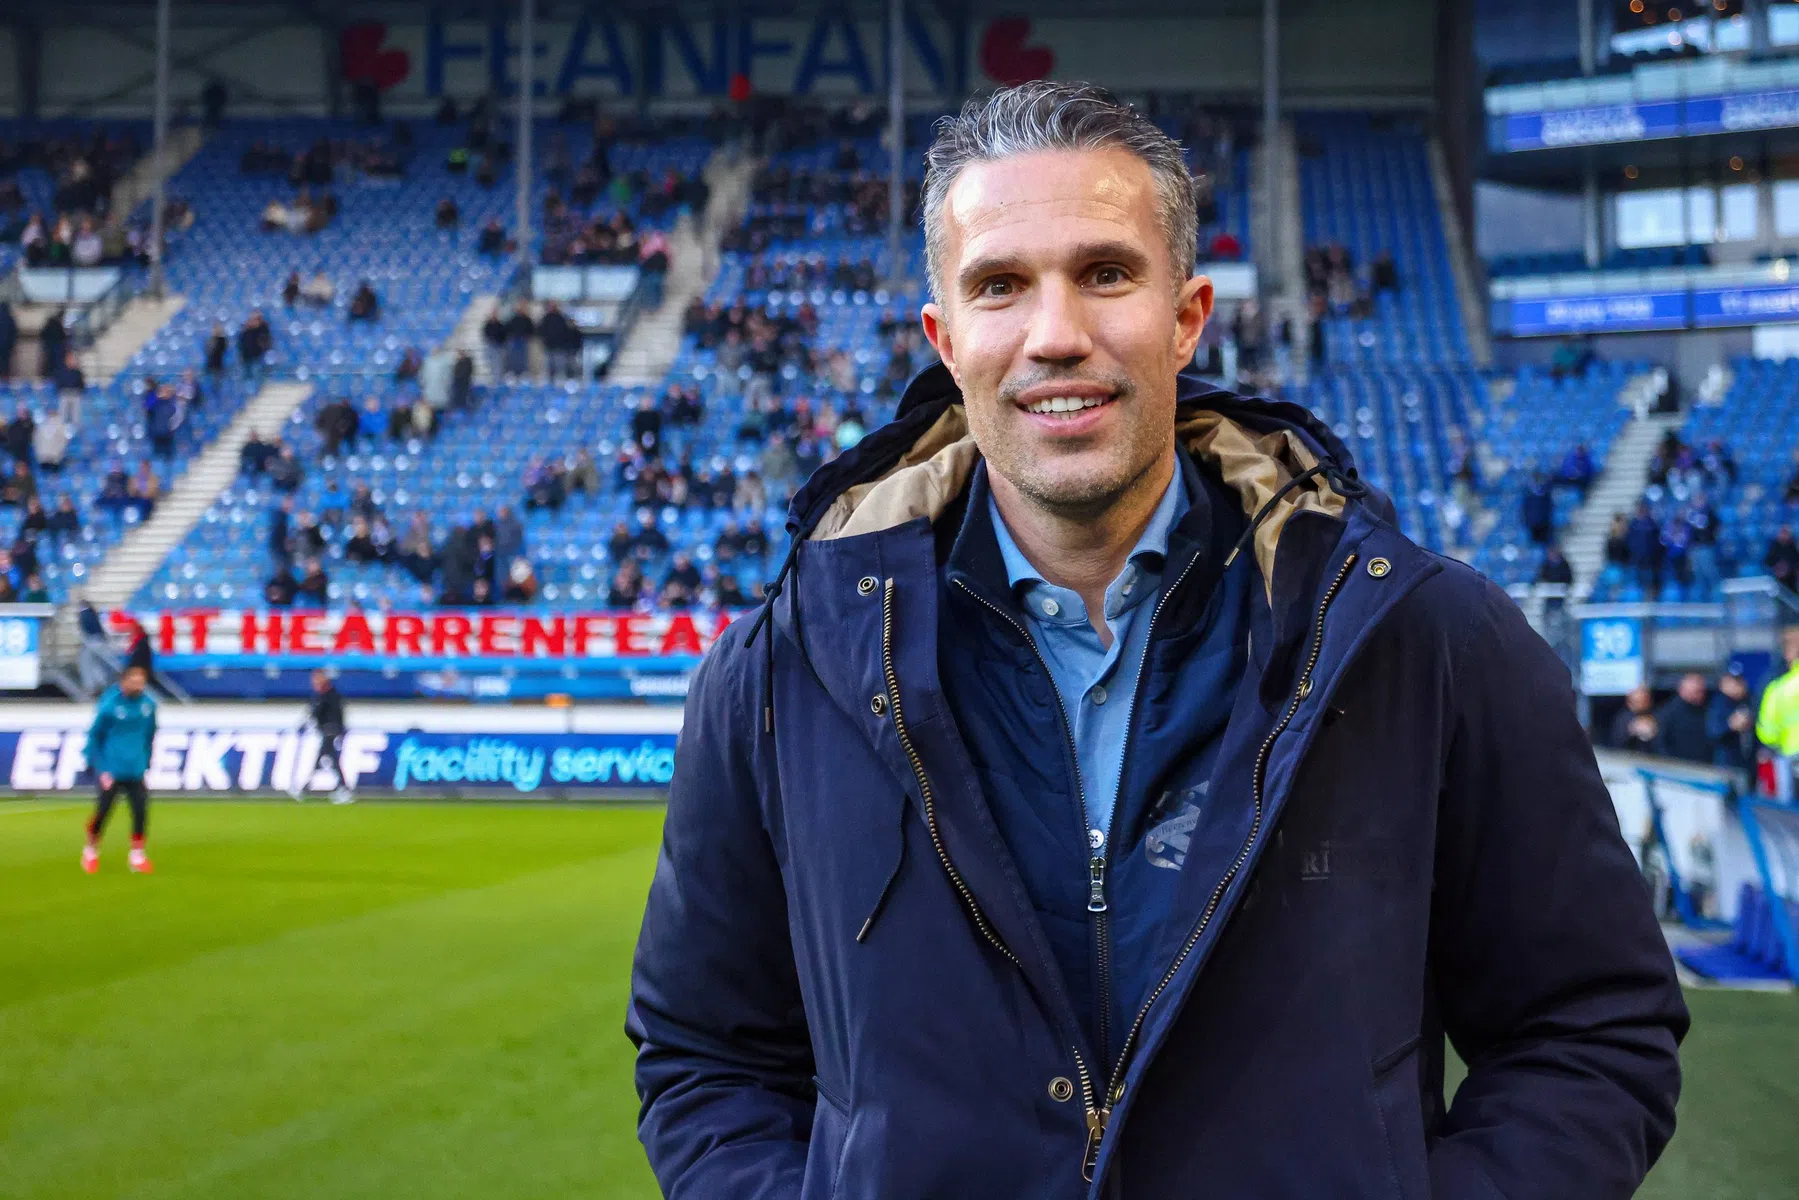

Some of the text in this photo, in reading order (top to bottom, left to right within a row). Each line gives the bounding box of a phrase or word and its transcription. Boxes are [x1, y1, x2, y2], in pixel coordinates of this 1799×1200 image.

[160, 607, 220, 656] IT
[11, 729, 389, 790] EFEKTIF
[393, 736, 545, 792] facility
